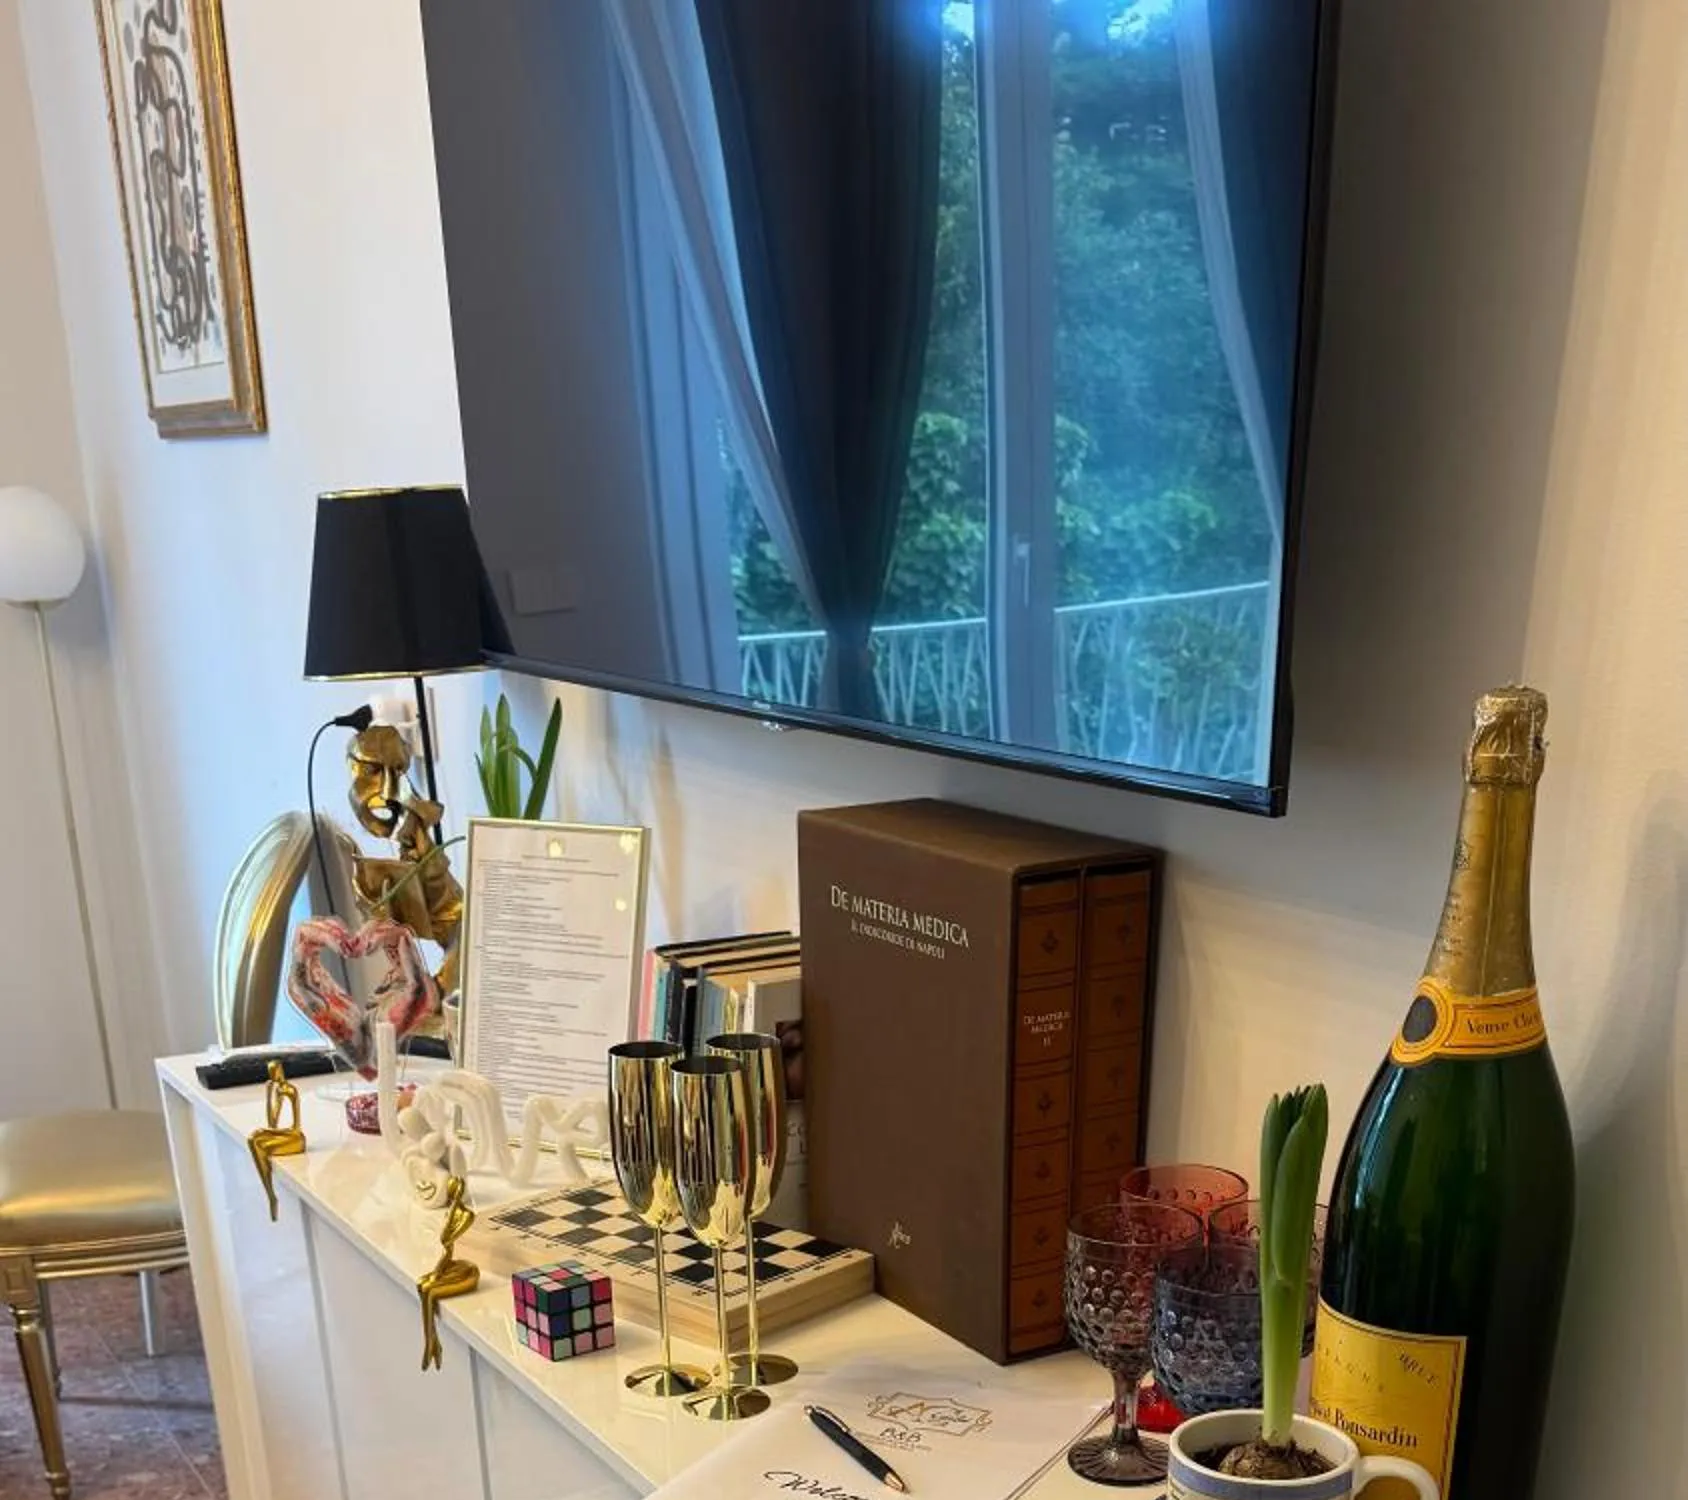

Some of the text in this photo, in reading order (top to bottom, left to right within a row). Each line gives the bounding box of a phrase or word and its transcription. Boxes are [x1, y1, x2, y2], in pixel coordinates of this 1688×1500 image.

[831, 885, 969, 948] DE MATERIA MEDICA
[1466, 1018, 1509, 1035] Veuve
[1334, 1407, 1418, 1448] Ponsardin
